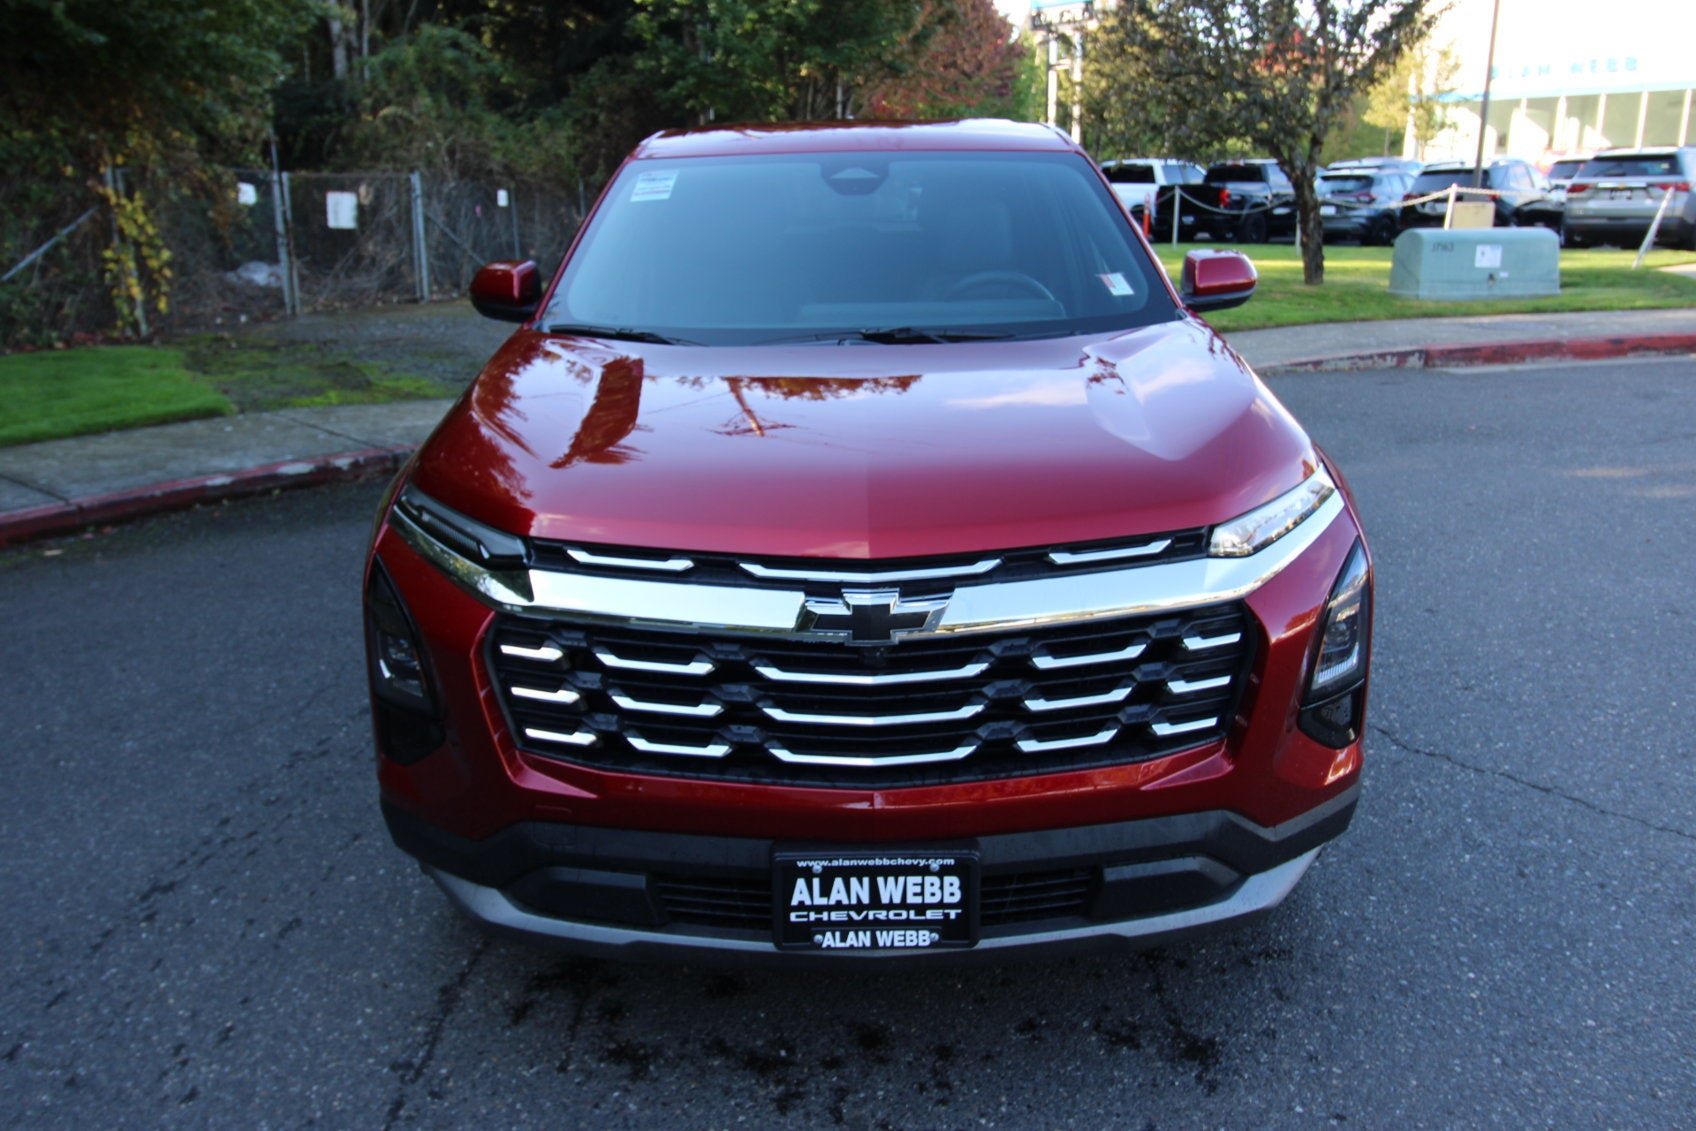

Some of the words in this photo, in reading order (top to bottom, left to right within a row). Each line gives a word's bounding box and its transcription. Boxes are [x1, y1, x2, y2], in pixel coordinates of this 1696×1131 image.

[1488, 63, 1551, 79] AN
[796, 857, 955, 868] www.alanwebbchevy.com
[790, 877, 870, 906] ALAN
[877, 875, 962, 904] WEBB
[789, 909, 962, 922] CHEVROLET
[822, 930, 872, 948] ALAN
[875, 930, 931, 947] WEBB
